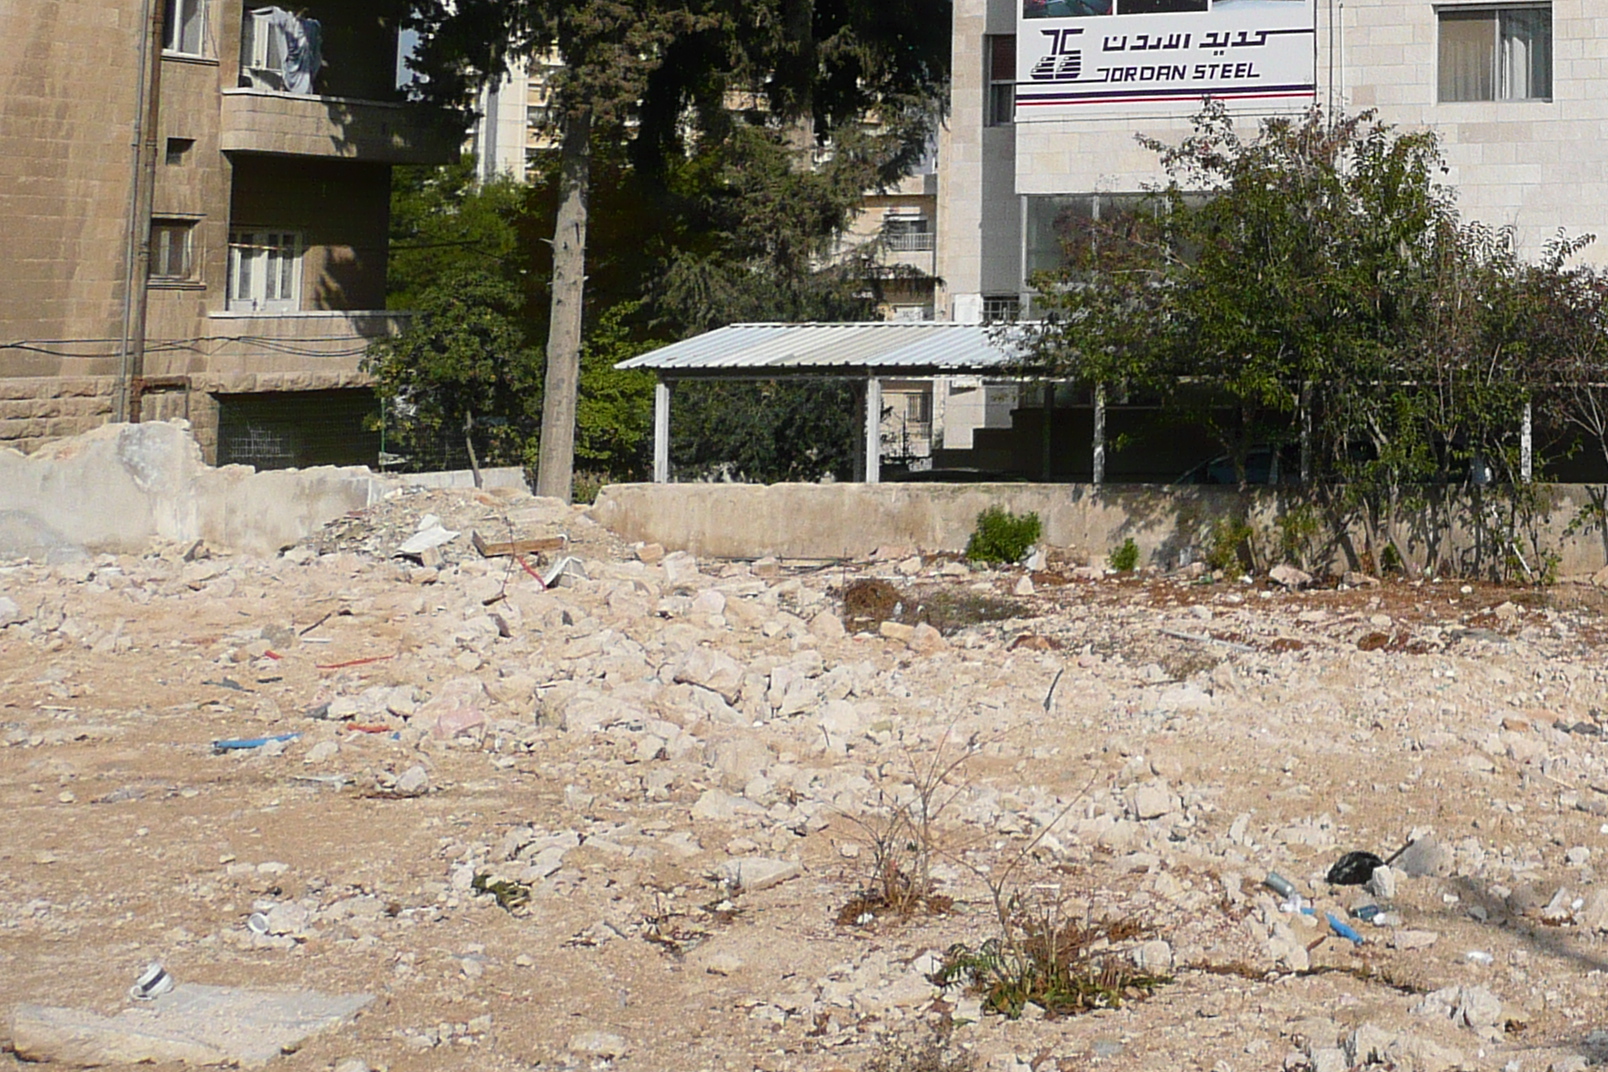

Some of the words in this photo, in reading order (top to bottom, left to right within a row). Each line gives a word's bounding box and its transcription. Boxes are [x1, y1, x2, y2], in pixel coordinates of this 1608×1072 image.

[1198, 30, 1272, 56] حديد
[1097, 65, 1187, 82] JORDAN
[1192, 63, 1261, 80] STEEL
